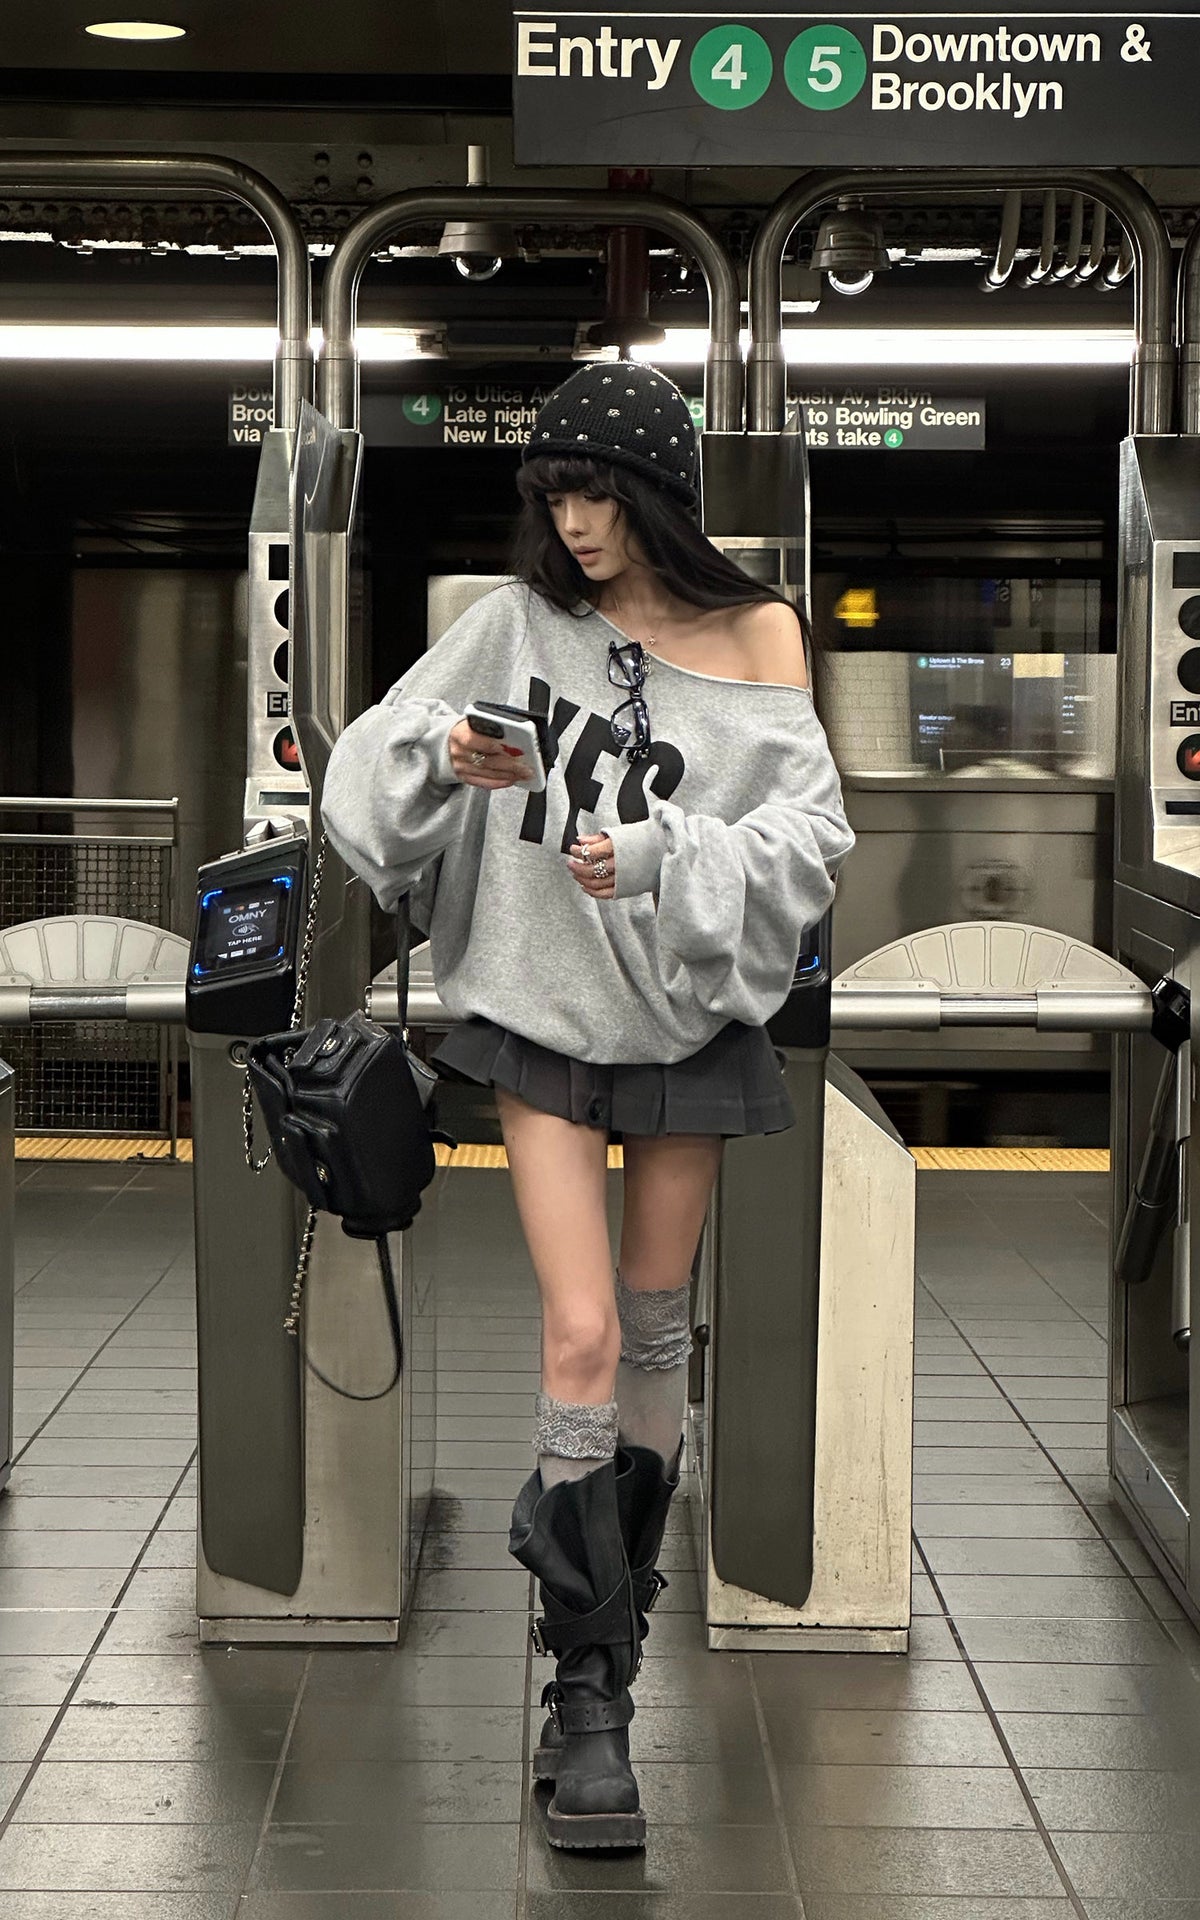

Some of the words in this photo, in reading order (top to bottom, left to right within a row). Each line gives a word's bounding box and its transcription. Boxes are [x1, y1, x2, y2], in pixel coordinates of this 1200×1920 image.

[871, 24, 1101, 62] Downtown
[1120, 24, 1152, 62] &
[517, 22, 681, 90] Entry
[711, 44, 747, 89] 4
[808, 46, 842, 92] 5
[871, 73, 1064, 118] Brooklyn
[445, 385, 467, 403] To
[475, 385, 523, 403] Utica
[877, 387, 933, 408] Bklyn
[412, 395, 430, 416] 4
[443, 405, 488, 423] Late
[494, 405, 538, 427] night
[807, 407, 829, 425] to
[835, 407, 913, 430] Bowling
[919, 407, 981, 426] Green
[232, 425, 261, 442] via
[443, 425, 488, 443] New
[494, 425, 532, 444] Lots
[836, 427, 882, 446] take
[888, 432, 898, 444] 4
[229, 909, 267, 923] OMNY
[242, 936, 262, 944] HERE
